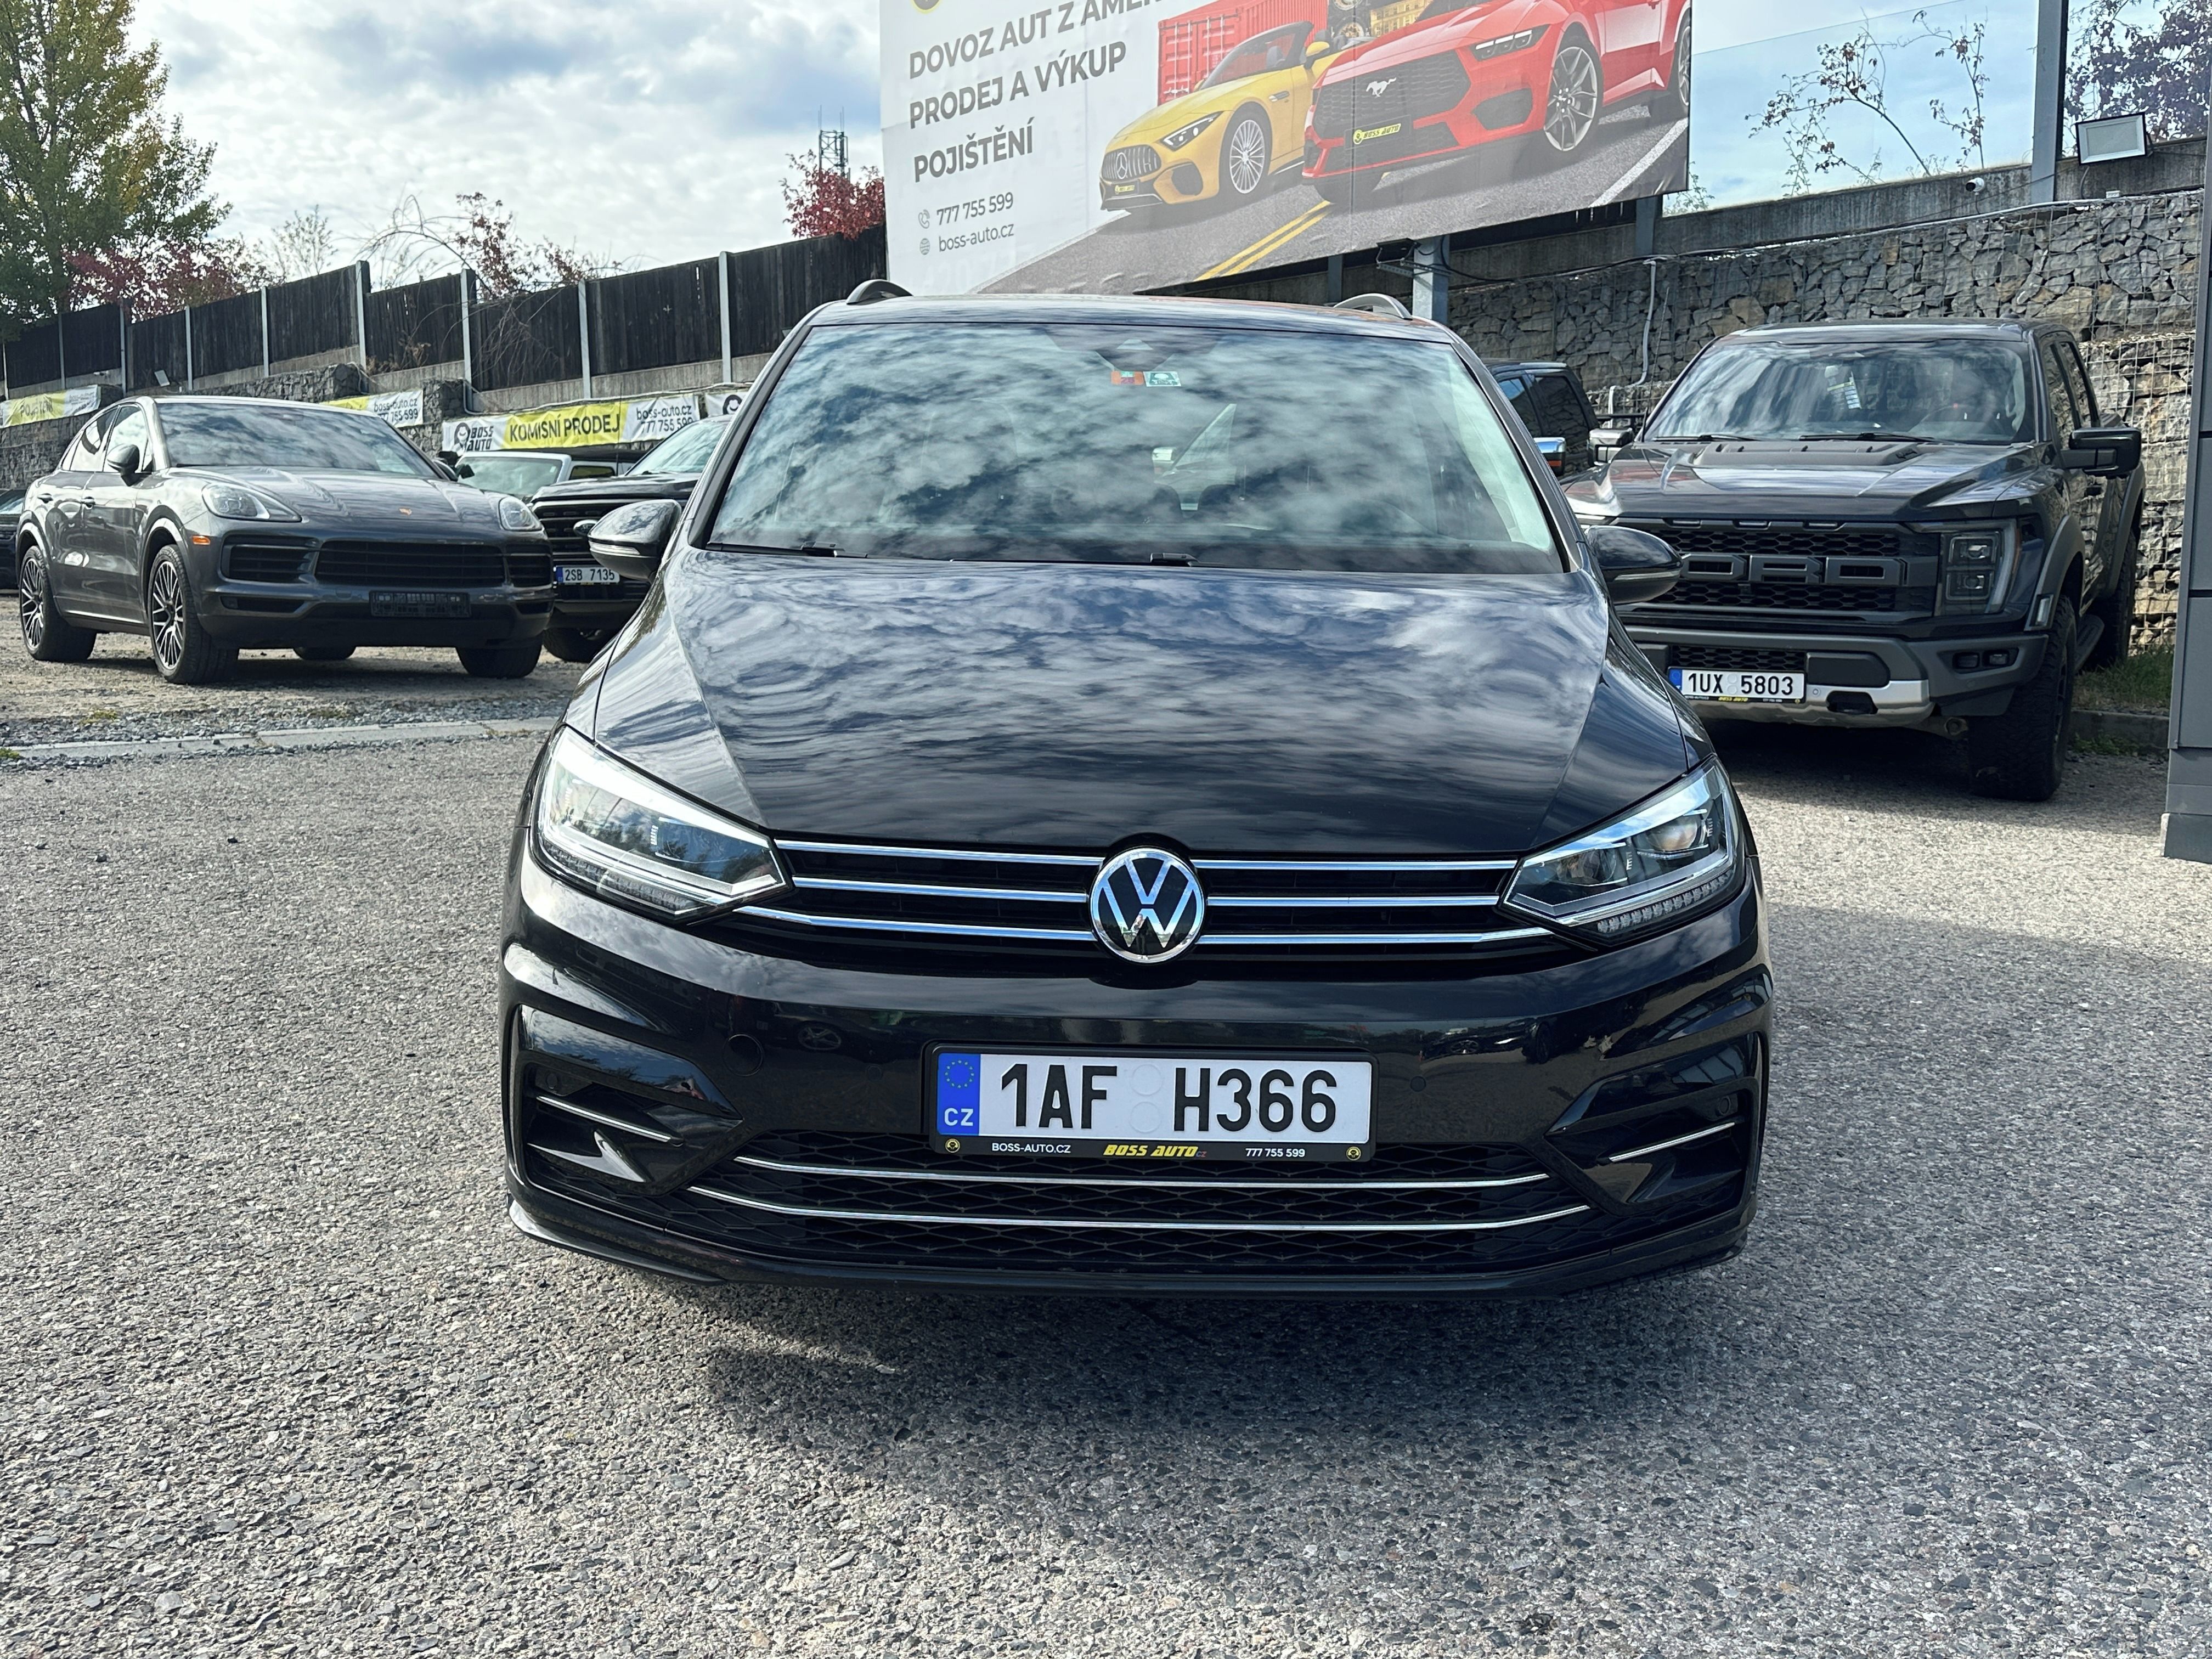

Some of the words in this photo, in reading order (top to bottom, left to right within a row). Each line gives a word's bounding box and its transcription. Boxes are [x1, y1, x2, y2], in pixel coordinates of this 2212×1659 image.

[910, 27, 994, 79] DOVOZ
[1000, 9, 1051, 51] AUT
[1058, 2, 1074, 33] Z
[910, 76, 1003, 129] PRODEJ
[1009, 70, 1029, 101] A
[1034, 41, 1126, 92] VÝKUP
[914, 117, 1035, 183] POJIŠTĚNÍ
[936, 205, 960, 225] 777
[963, 199, 986, 219] 755
[989, 192, 1013, 213] 599
[939, 224, 1014, 252] boss-auto.cz
[404, 408, 418, 420] 599
[636, 405, 692, 420] boss-auto.cz
[470, 425, 494, 439] BOSS
[510, 414, 561, 443] KOMISNÍ
[564, 414, 620, 437] PRODEJ
[658, 419, 674, 432] 755
[466, 438, 492, 452] AUTO
[565, 569, 583, 581] 2SB
[590, 569, 615, 581] 7135
[1680, 554, 1901, 586] ORD
[1688, 673, 1723, 693] 1UX
[1741, 675, 1793, 695] 5803
[1001, 1063, 1118, 1129] 1AF
[1173, 1068, 1337, 1133] H366
[944, 1108, 974, 1126] CZ
[991, 1143, 1071, 1153] BOSS-AUTO.CZ
[1103, 1144, 1148, 1156] BOSS
[1150, 1146, 1198, 1156] AUTO
[1245, 1147, 1262, 1157] 777
[1265, 1148, 1284, 1158] 755
[1286, 1148, 1305, 1158] 599
